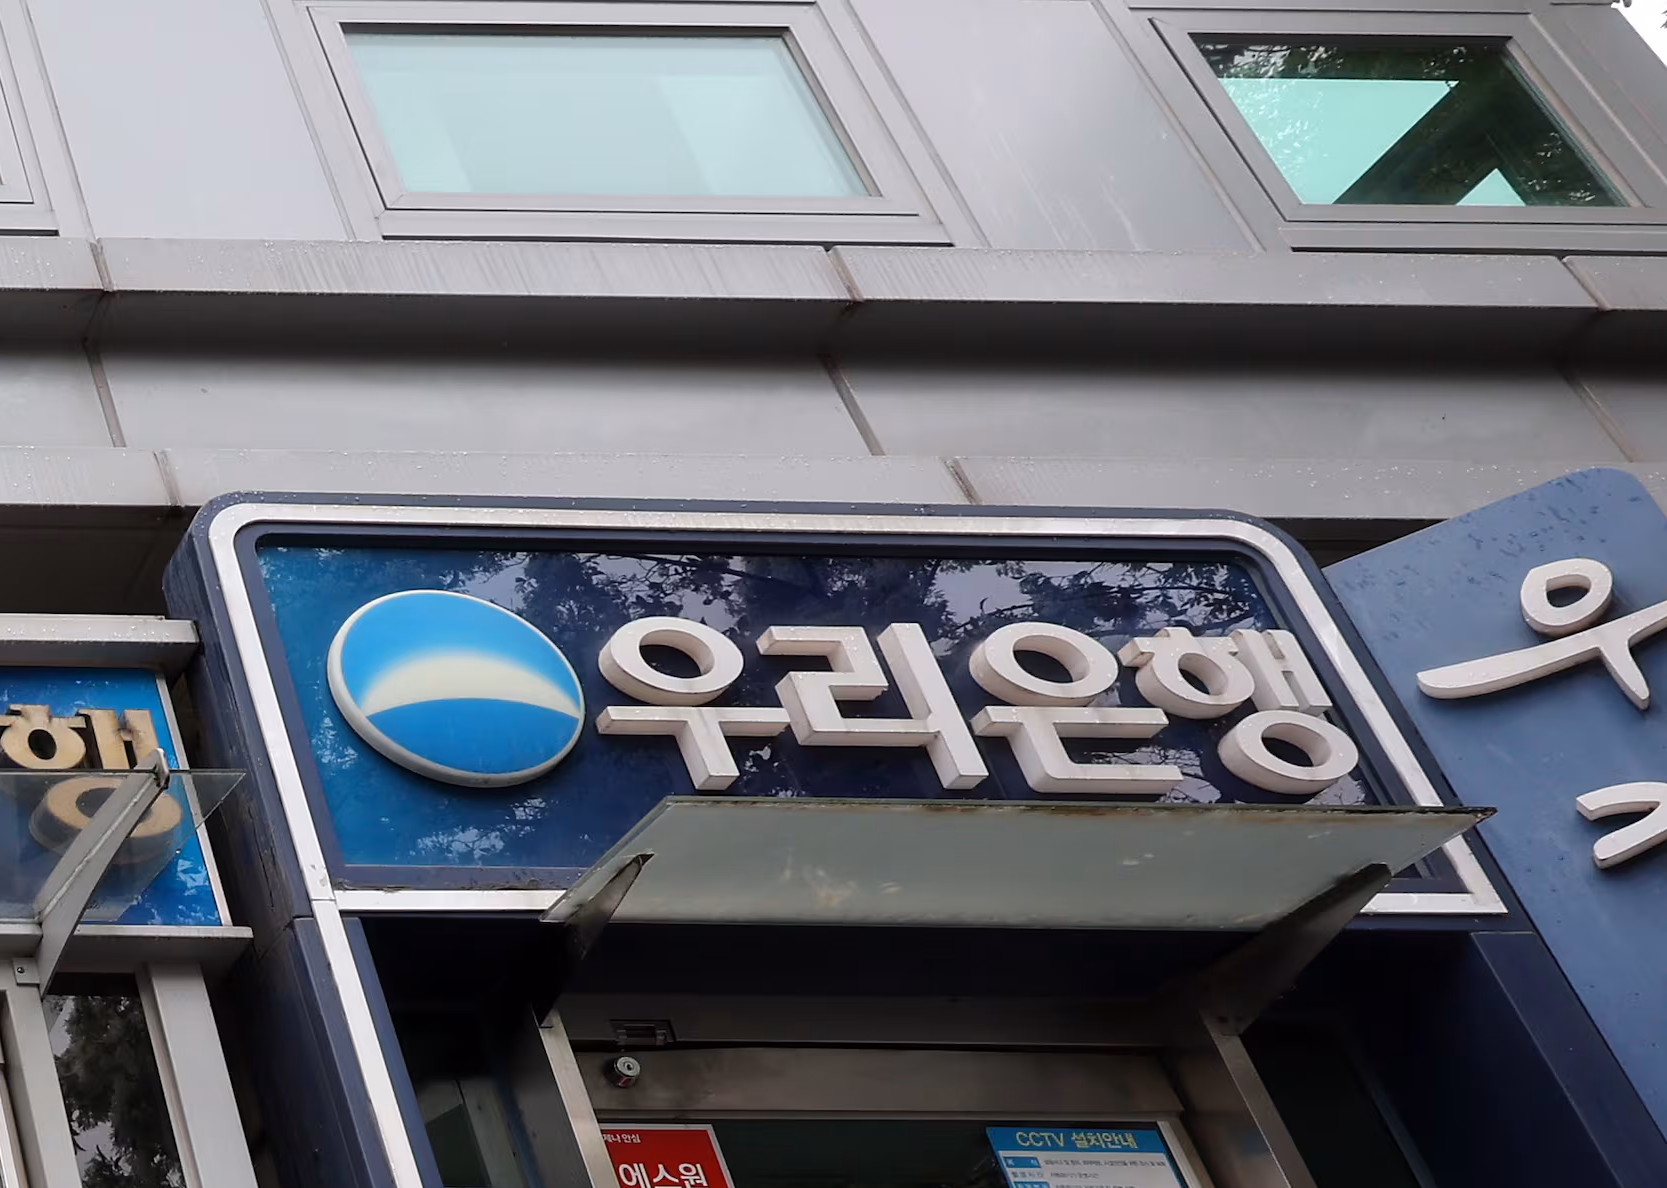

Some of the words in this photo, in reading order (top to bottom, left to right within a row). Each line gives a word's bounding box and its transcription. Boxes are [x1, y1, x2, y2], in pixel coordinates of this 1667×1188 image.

[597, 613, 1361, 796] 우리은행
[621, 1133, 641, 1144] 안심
[1015, 1131, 1065, 1147] CCTV
[1071, 1131, 1139, 1149] 설치안내
